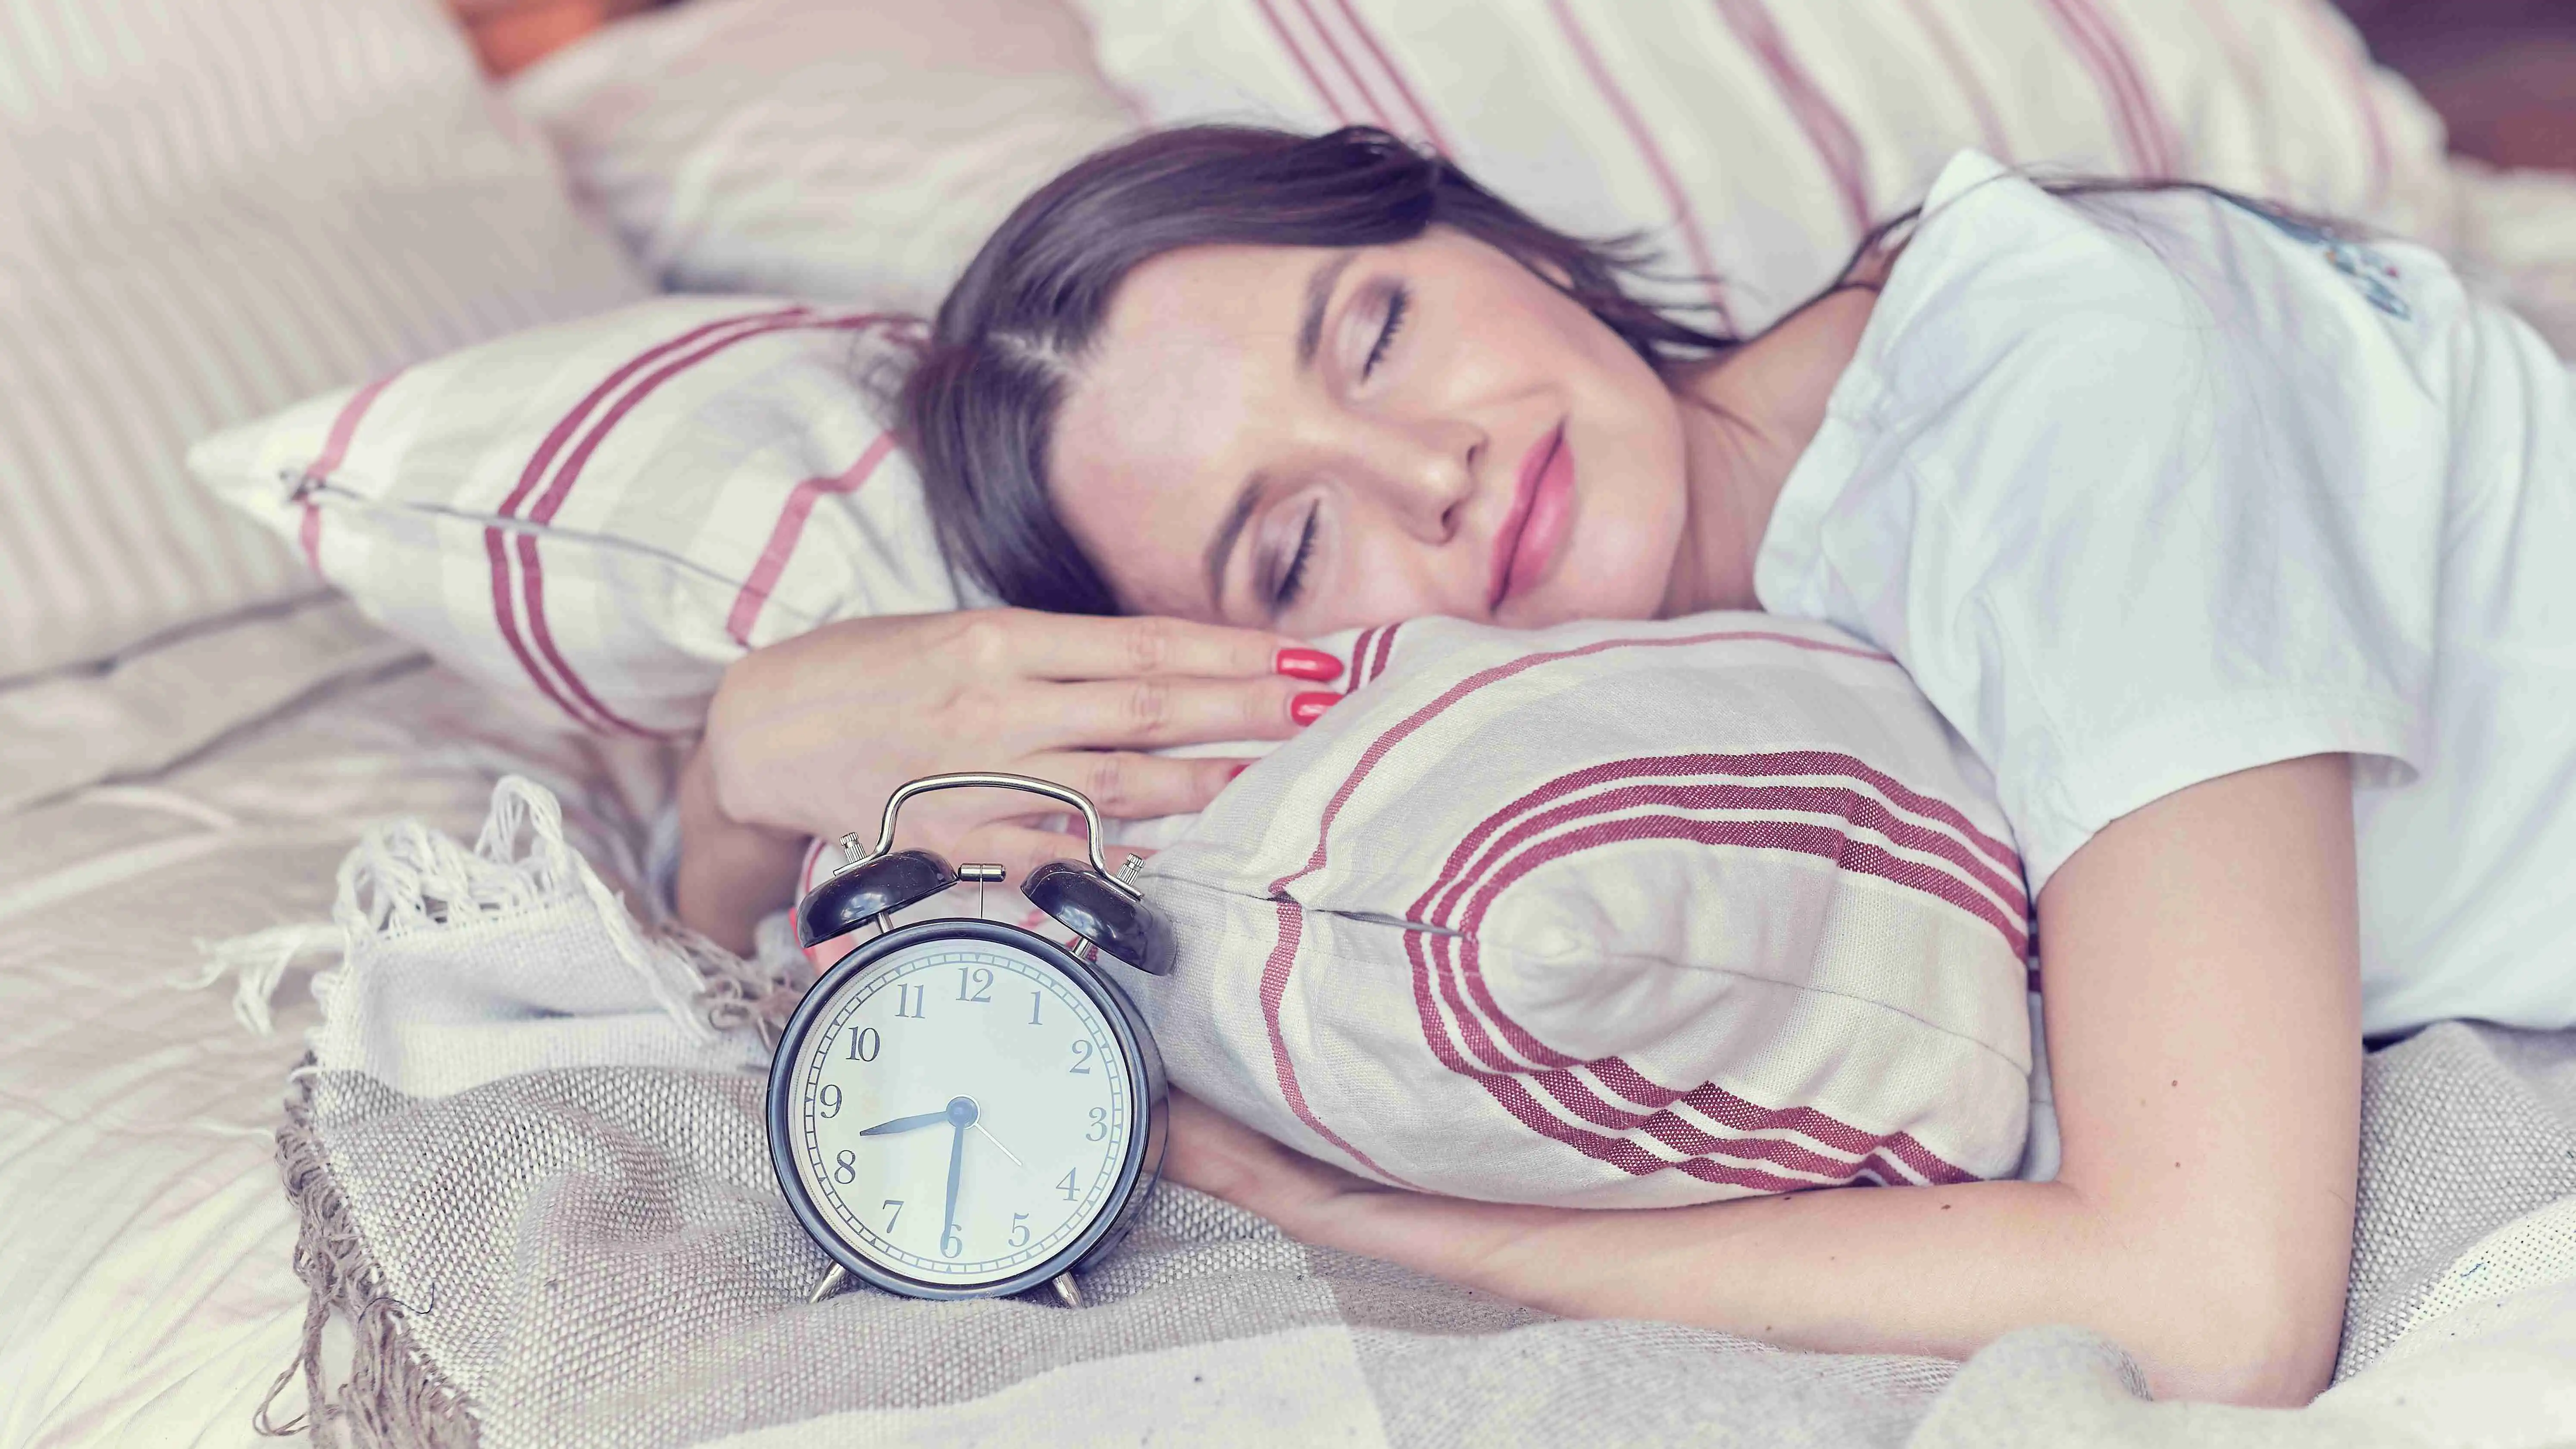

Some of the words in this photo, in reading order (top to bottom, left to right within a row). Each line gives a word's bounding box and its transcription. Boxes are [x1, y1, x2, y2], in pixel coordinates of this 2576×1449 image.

[895, 983, 925, 1019] 11
[955, 967, 994, 1003] 12
[1028, 991, 1043, 1025] 1
[846, 1026, 880, 1062] 10
[1069, 1040, 1093, 1074] 2
[820, 1084, 842, 1119] 9
[1086, 1107, 1107, 1141] 3
[834, 1150, 856, 1184] 8
[1055, 1167, 1080, 1202] 4
[883, 1200, 904, 1233] 7
[1008, 1212, 1030, 1247] 5
[940, 1224, 962, 1258] 6
